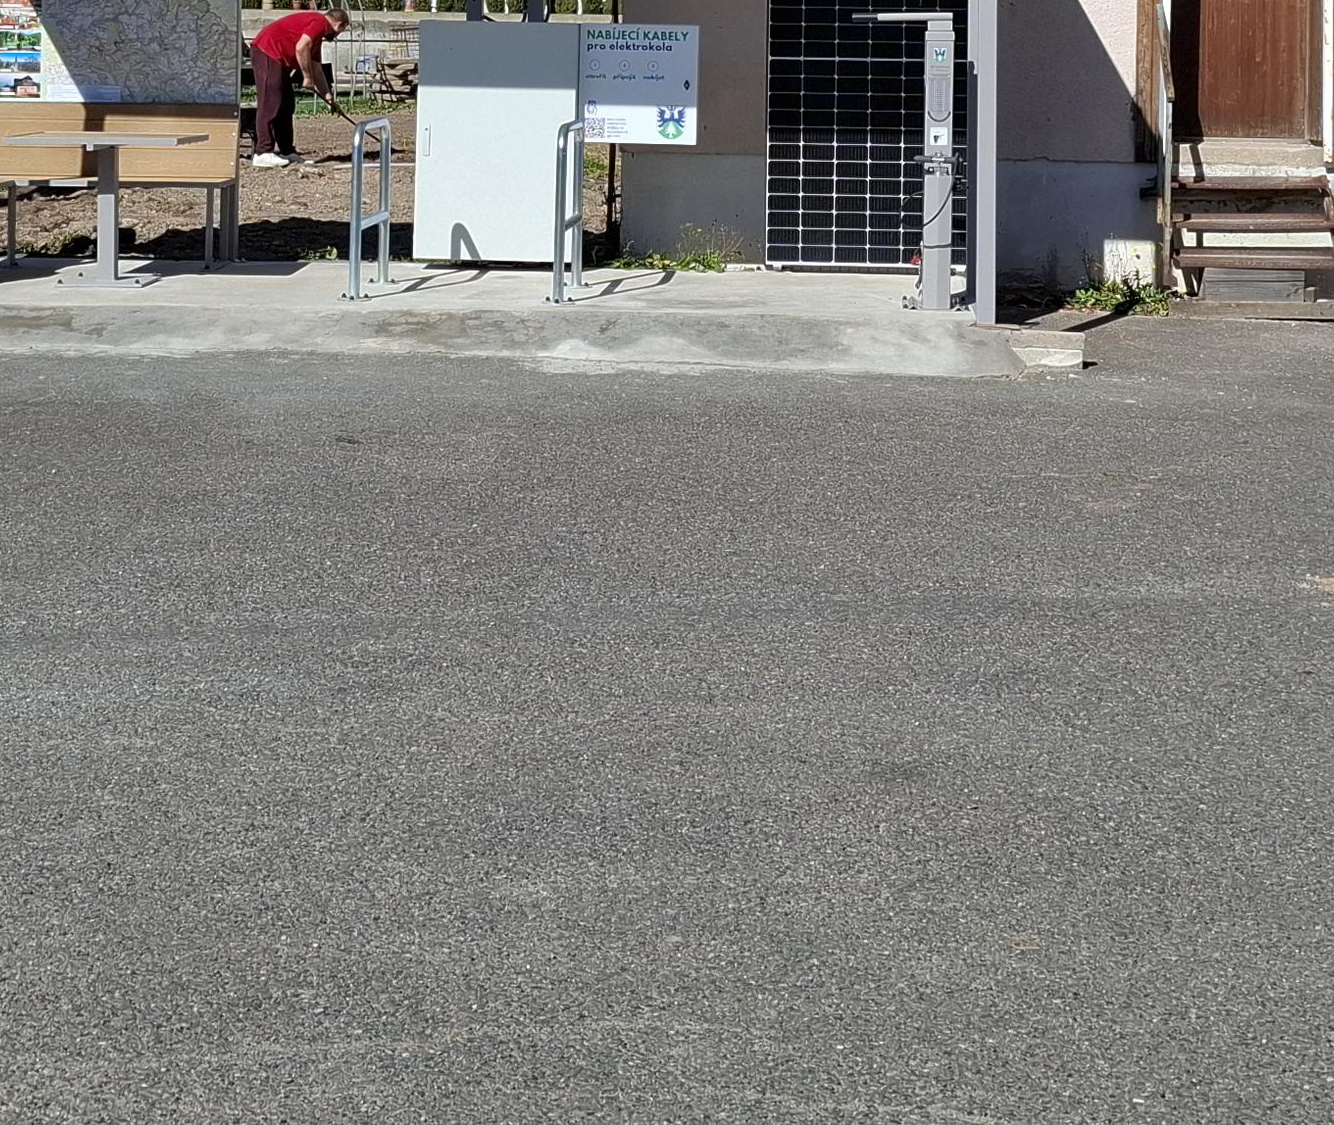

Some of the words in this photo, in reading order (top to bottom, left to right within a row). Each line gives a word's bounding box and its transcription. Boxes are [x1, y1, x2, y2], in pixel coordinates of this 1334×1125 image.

[587, 27, 639, 41] NABÍJECÍ
[643, 31, 689, 42] KABELY
[587, 42, 606, 52] pro
[609, 42, 673, 52] elektrokola
